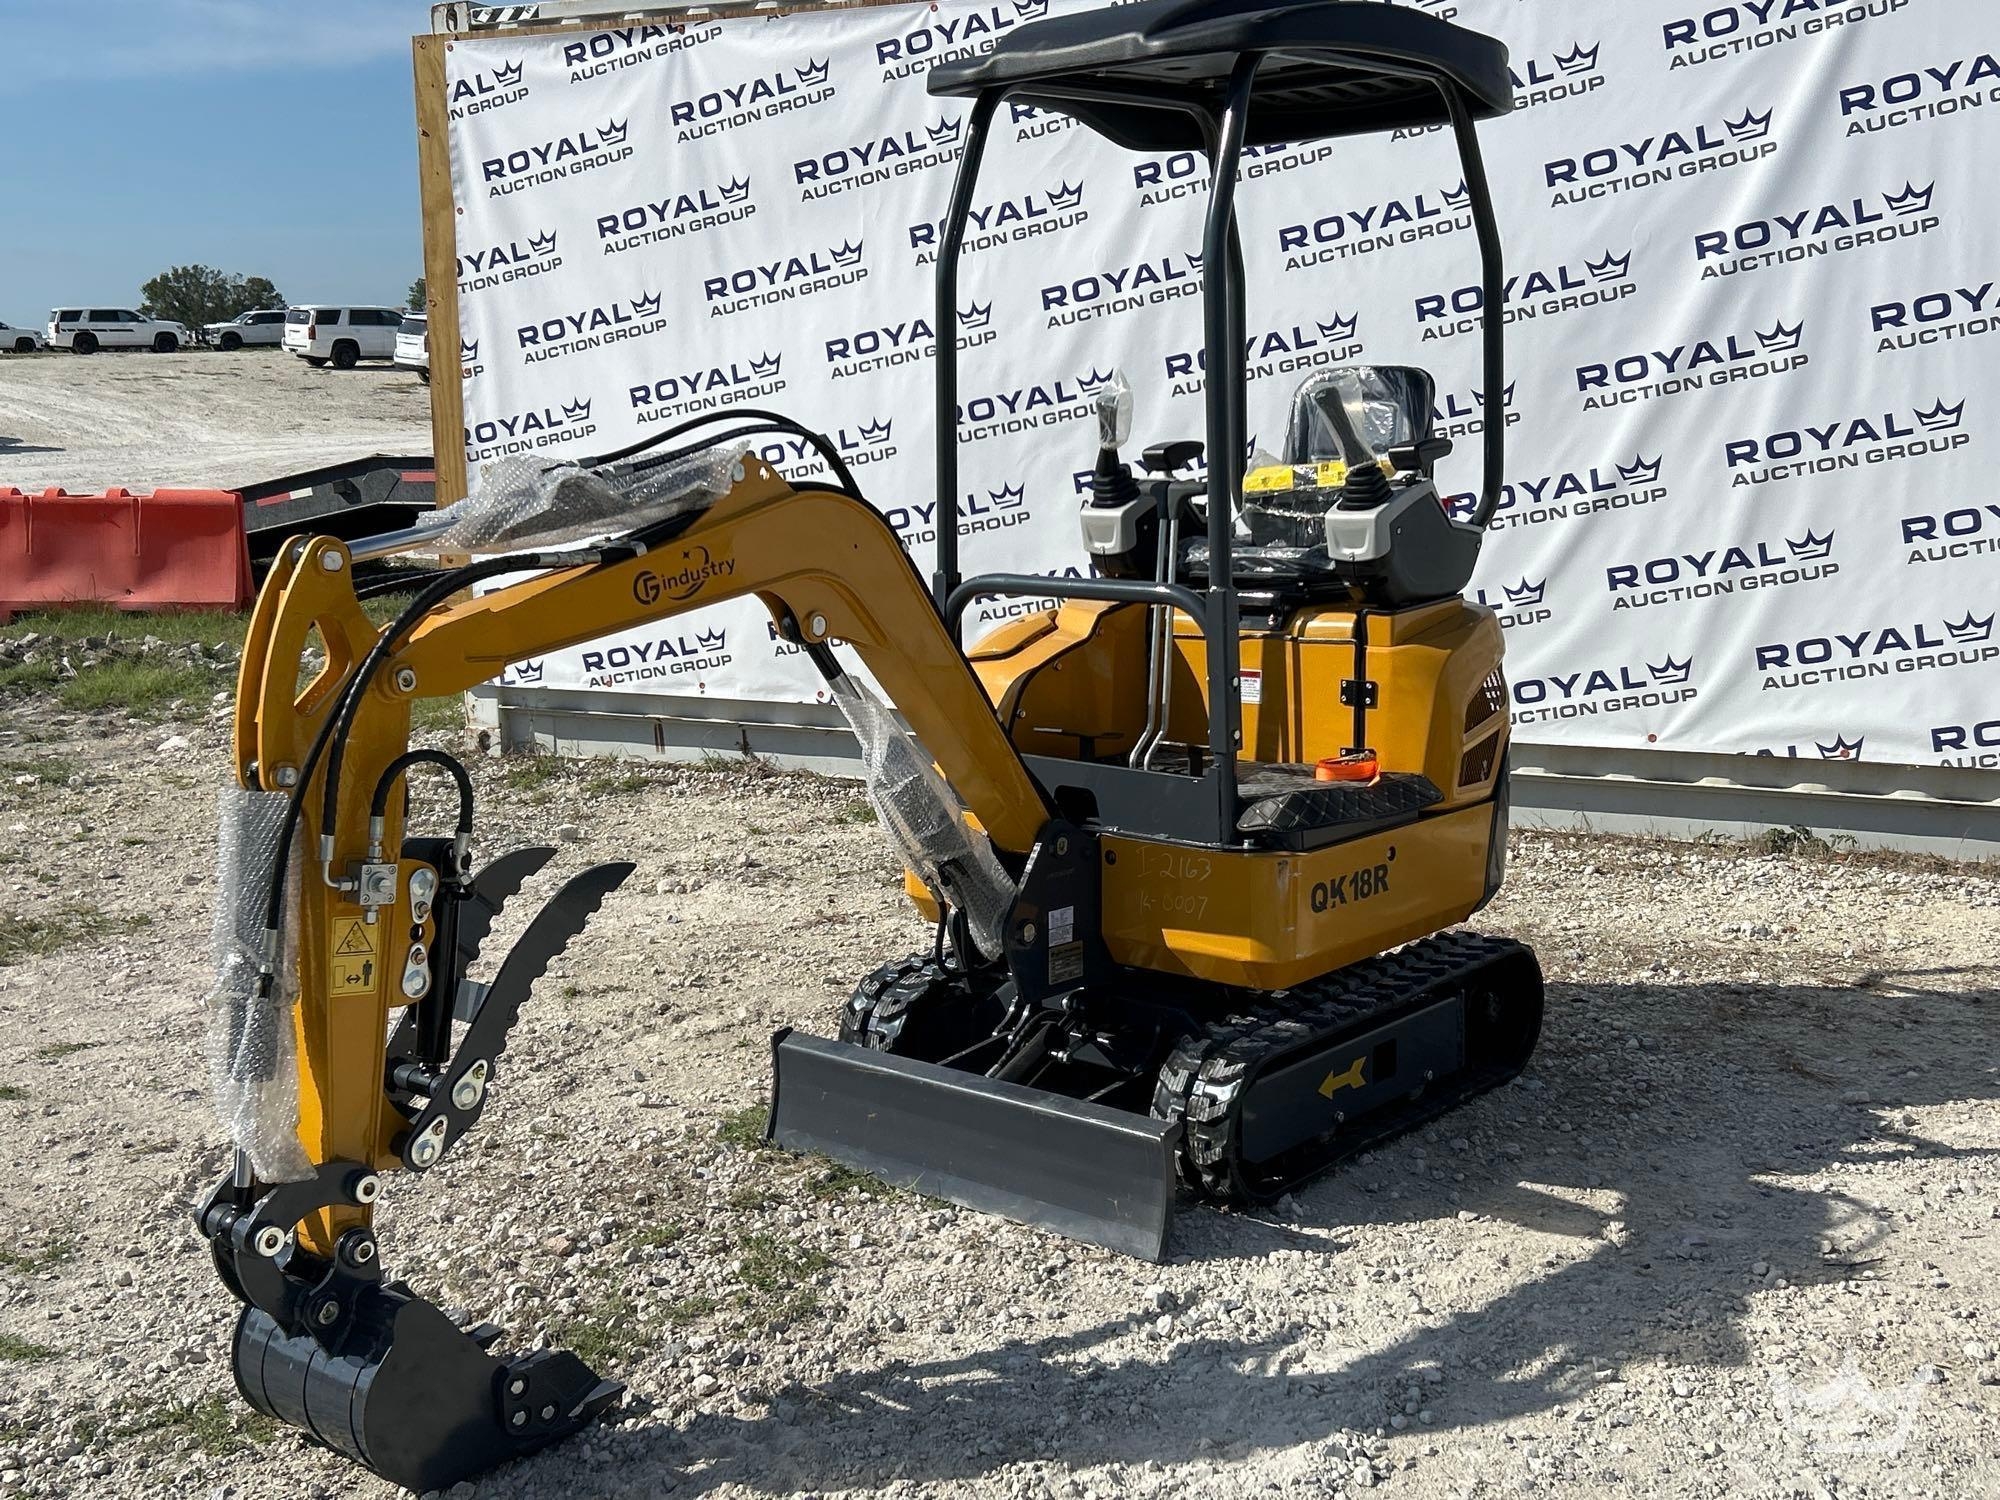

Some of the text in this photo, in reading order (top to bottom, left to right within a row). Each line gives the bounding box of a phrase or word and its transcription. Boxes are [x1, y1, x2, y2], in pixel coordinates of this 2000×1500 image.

[876, 8, 1013, 64] ROYAL
[1663, 0, 1850, 49] ROYA
[1670, 0, 1908, 70] AUCTION GROUP
[571, 27, 722, 84] AUCTION GROUP
[467, 88, 529, 115] GROUP
[671, 73, 797, 126] ROYAL
[678, 87, 835, 143] AUCTION GROUP
[1512, 76, 1605, 110] GROUP
[1846, 92, 1982, 137] AUCTION
[482, 133, 598, 182] ROYAL
[490, 147, 633, 198] AUCTION GROUP
[794, 131, 927, 184] ROYAL
[802, 147, 963, 202] AUCTION GROUP
[1140, 171, 1240, 207] AUCTI
[1248, 146, 1332, 178] GROUP
[1545, 125, 1725, 187] ROYAL
[1551, 142, 1777, 208] AUCTION GROUP
[597, 190, 720, 239] ROYAL
[604, 205, 756, 255] AUCTION GROUP
[909, 195, 1047, 248] RYAL
[915, 211, 1088, 266] ATION GROUP
[1279, 195, 1441, 252] ROYAL
[1695, 198, 1883, 260] ROYAL
[457, 240, 529, 279] YAL
[1285, 215, 1472, 271] AUCTION GROU
[1701, 217, 1939, 280] AUCTION GROUP
[459, 257, 562, 293] TION GROUP
[704, 253, 831, 301] ROYAL
[711, 268, 868, 318] AUCTION GROUP
[1041, 258, 1186, 311] ROYAL
[518, 303, 632, 348] ROYAL
[1048, 277, 1203, 329] AUCTION GRO
[1421, 283, 1636, 341] AUCTON GROUP
[525, 319, 666, 364] AUCTION GROUP
[825, 319, 934, 361] ROYA
[832, 331, 996, 379] AUCTION GOUP
[1165, 325, 1317, 379] RAL
[1576, 336, 1755, 391] ROYAL
[629, 364, 750, 408] ROYAL
[1172, 344, 1363, 398] AUON GROUP
[1583, 354, 1808, 411] AUCTION GROUP
[637, 380, 786, 424] AUCTION GROUP
[957, 402, 1098, 443] UCTION GROU
[1434, 412, 1521, 439] GROP
[467, 425, 596, 462] UCTION GROUP
[829, 447, 897, 471] ROUP
[1725, 413, 1914, 467] ROYAL
[1732, 434, 1969, 487] AUCTION GROUP
[957, 511, 1030, 536] GROUP
[1488, 488, 1667, 531] CTION GROUP
[662, 558, 735, 590] industry
[1606, 542, 1785, 591] ROYAL
[1613, 563, 1839, 611] AUCTION GROUP
[582, 637, 698, 672] ROYAL
[589, 655, 731, 687] AUCTION GROUP
[1755, 624, 1943, 670] ROYAL
[1762, 647, 2000, 690] AUCTION GROUP
[1511, 688, 1697, 725] CTION GROUP
[1514, 666, 1646, 703] OYAL
[1311, 864, 1389, 913] QK18R
